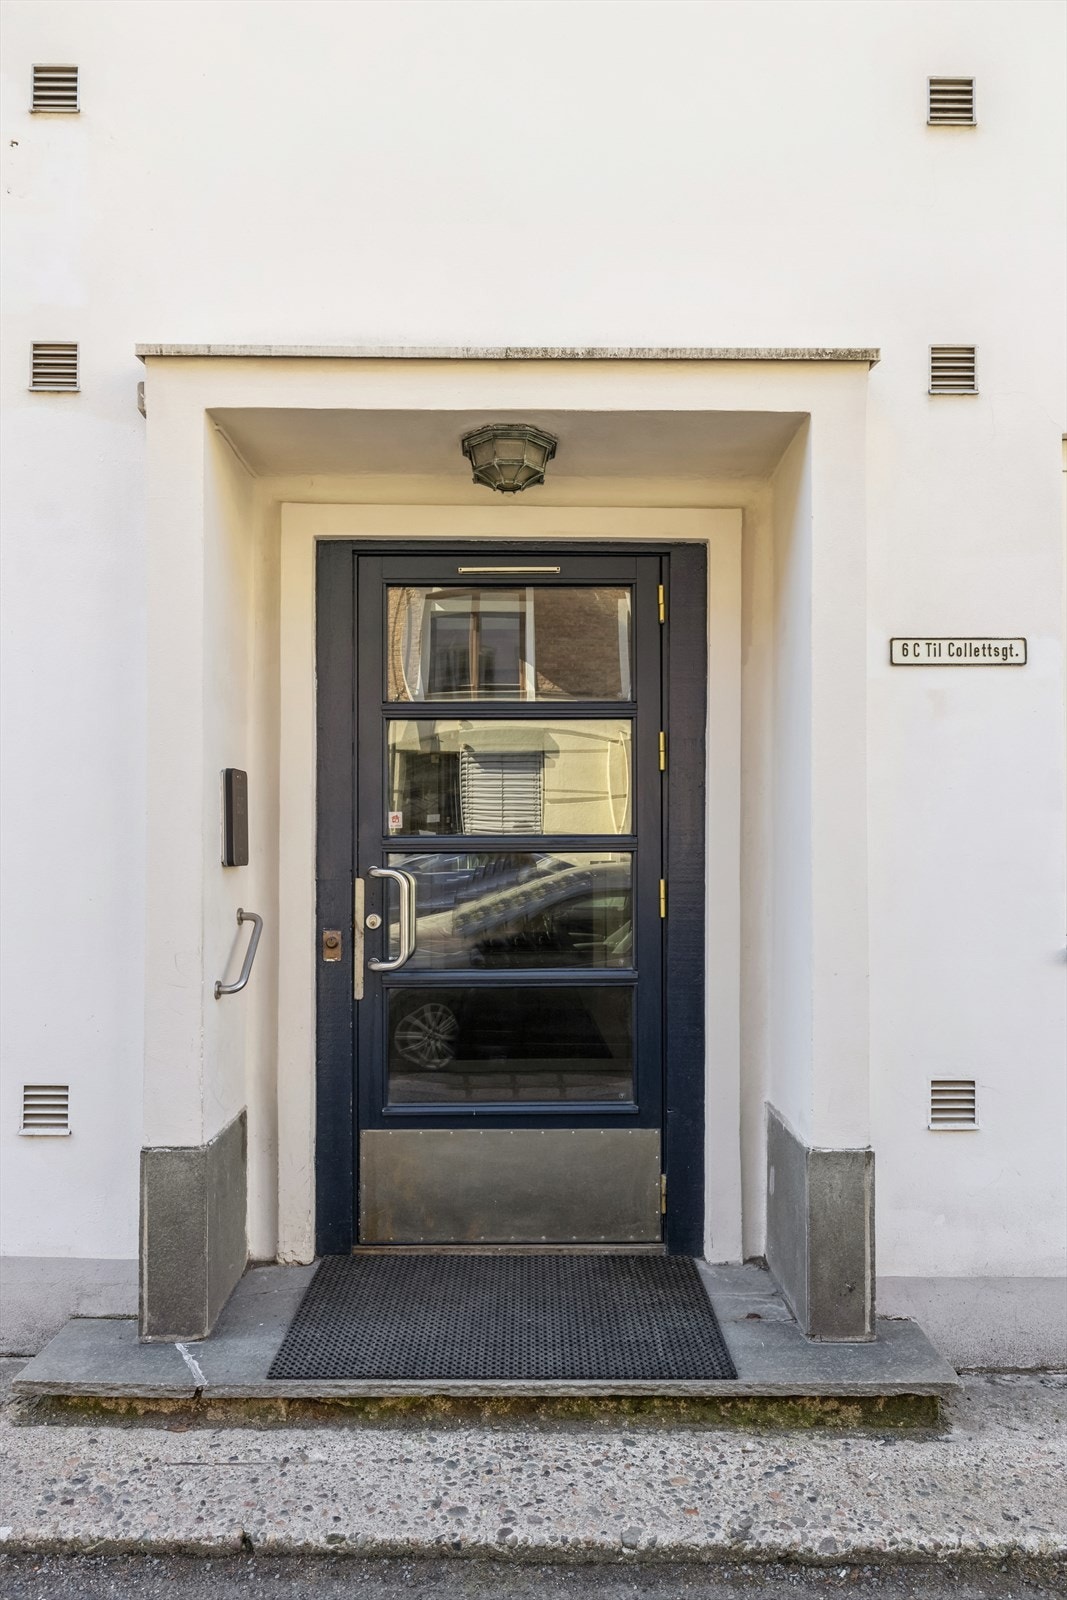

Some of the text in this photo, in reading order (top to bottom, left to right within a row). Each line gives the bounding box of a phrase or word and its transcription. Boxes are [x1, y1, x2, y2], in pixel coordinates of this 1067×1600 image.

[902, 642, 1019, 661] 6 C Til Collettsgt.
